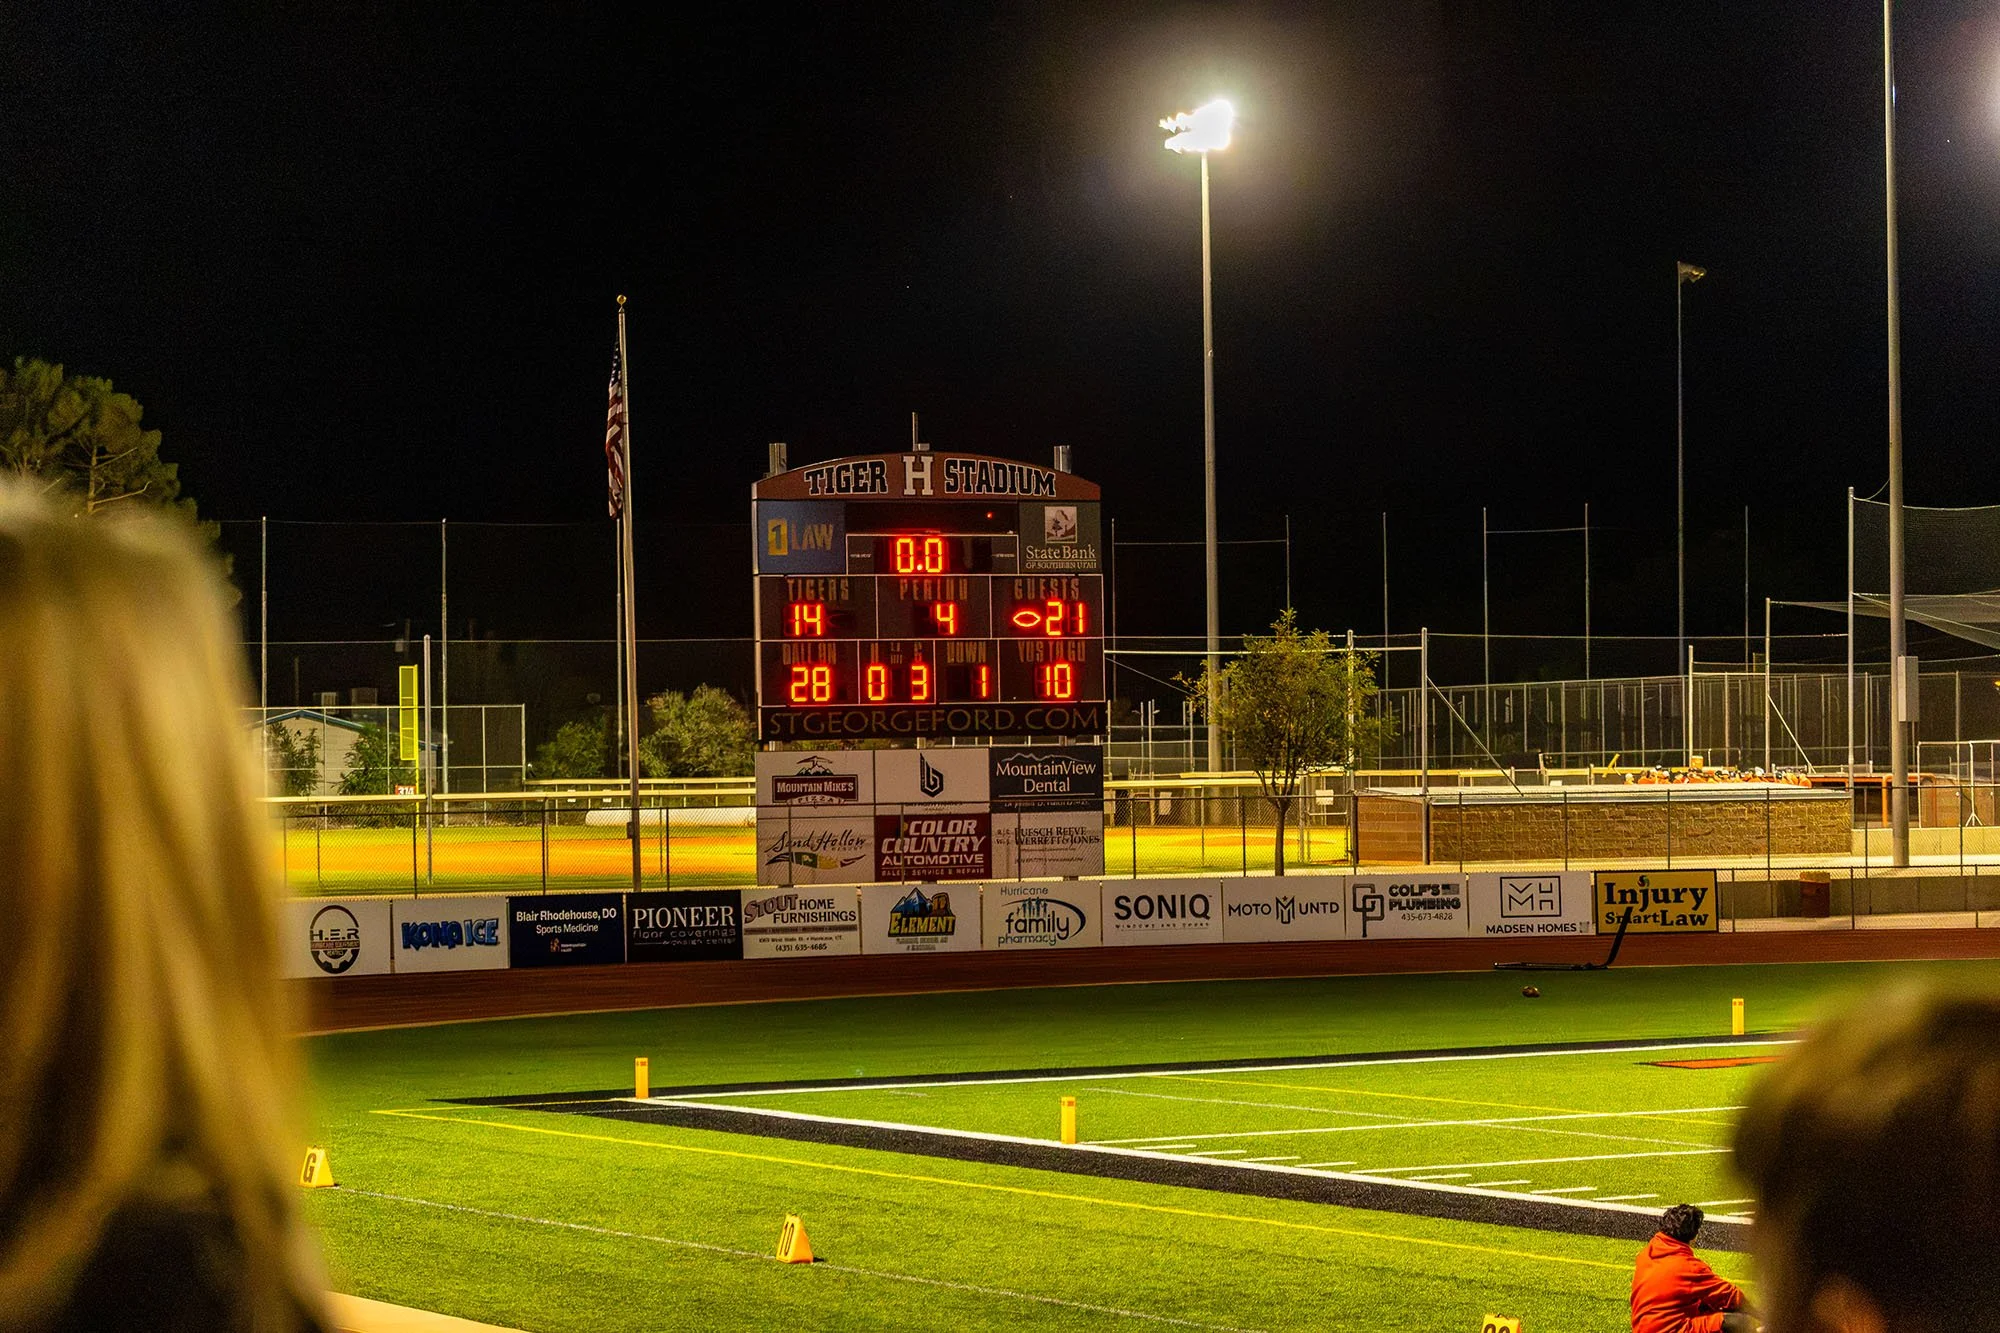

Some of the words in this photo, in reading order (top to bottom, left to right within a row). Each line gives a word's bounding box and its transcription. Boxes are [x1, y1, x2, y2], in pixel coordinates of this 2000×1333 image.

[804, 459, 888, 496] TIGER
[903, 455, 934, 496] H
[944, 458, 1056, 497] STADIUM
[791, 520, 834, 551] LAW
[896, 537, 943, 574] 0.0
[1026, 544, 1060, 560] State
[1062, 544, 1096, 560] Bank
[1038, 561, 1075, 569] SOUTHERN
[1077, 560, 1097, 569] UTAH
[787, 578, 849, 601] TIGERS
[1014, 577, 1080, 600] GUESTS
[794, 604, 822, 637] 14
[936, 603, 954, 636] 4
[1045, 601, 1084, 636] 21
[947, 641, 987, 664] DOWN
[790, 666, 830, 702] 28
[867, 665, 885, 701] 0
[911, 665, 928, 701] 3
[1045, 664, 1071, 699] 10
[770, 707, 1099, 736] STGEORGEFORD.COM
[996, 760, 1096, 777] MountainView
[777, 782, 822, 793] MOUNTAIN
[824, 781, 854, 792] MIKE'S
[1024, 777, 1070, 793] Dental
[909, 819, 978, 836] COLOR
[881, 835, 987, 854] COUNTRY
[881, 853, 984, 866] AUTOMOTIVE
[1000, 886, 1049, 896] Hurricane
[1604, 875, 1709, 912] Injury
[516, 911, 539, 922] Blair
[540, 909, 601, 921] Rhodehouse,
[602, 907, 617, 919] DO
[744, 893, 799, 925] STOUT
[799, 898, 835, 910] HOME
[1114, 893, 1211, 921] SONIQ
[1228, 903, 1272, 917] MOTO
[1298, 902, 1340, 915] UNTD
[1389, 897, 1462, 911] PLUMBING
[632, 905, 737, 929] PIONEER
[773, 910, 857, 924] FURNISHINGS
[889, 912, 956, 934] ELEMENT
[1005, 910, 1070, 941] family
[1486, 924, 1535, 934] MADSEN
[1537, 923, 1577, 933] HOMES
[464, 918, 499, 946] ICE
[536, 924, 562, 936] Sports
[563, 923, 599, 933] Medicine
[633, 929, 664, 939] floor
[670, 928, 736, 939] coverings
[998, 932, 1057, 947] pharmacy
[303, 1152, 317, 1183] G
[779, 1221, 795, 1257] 10
